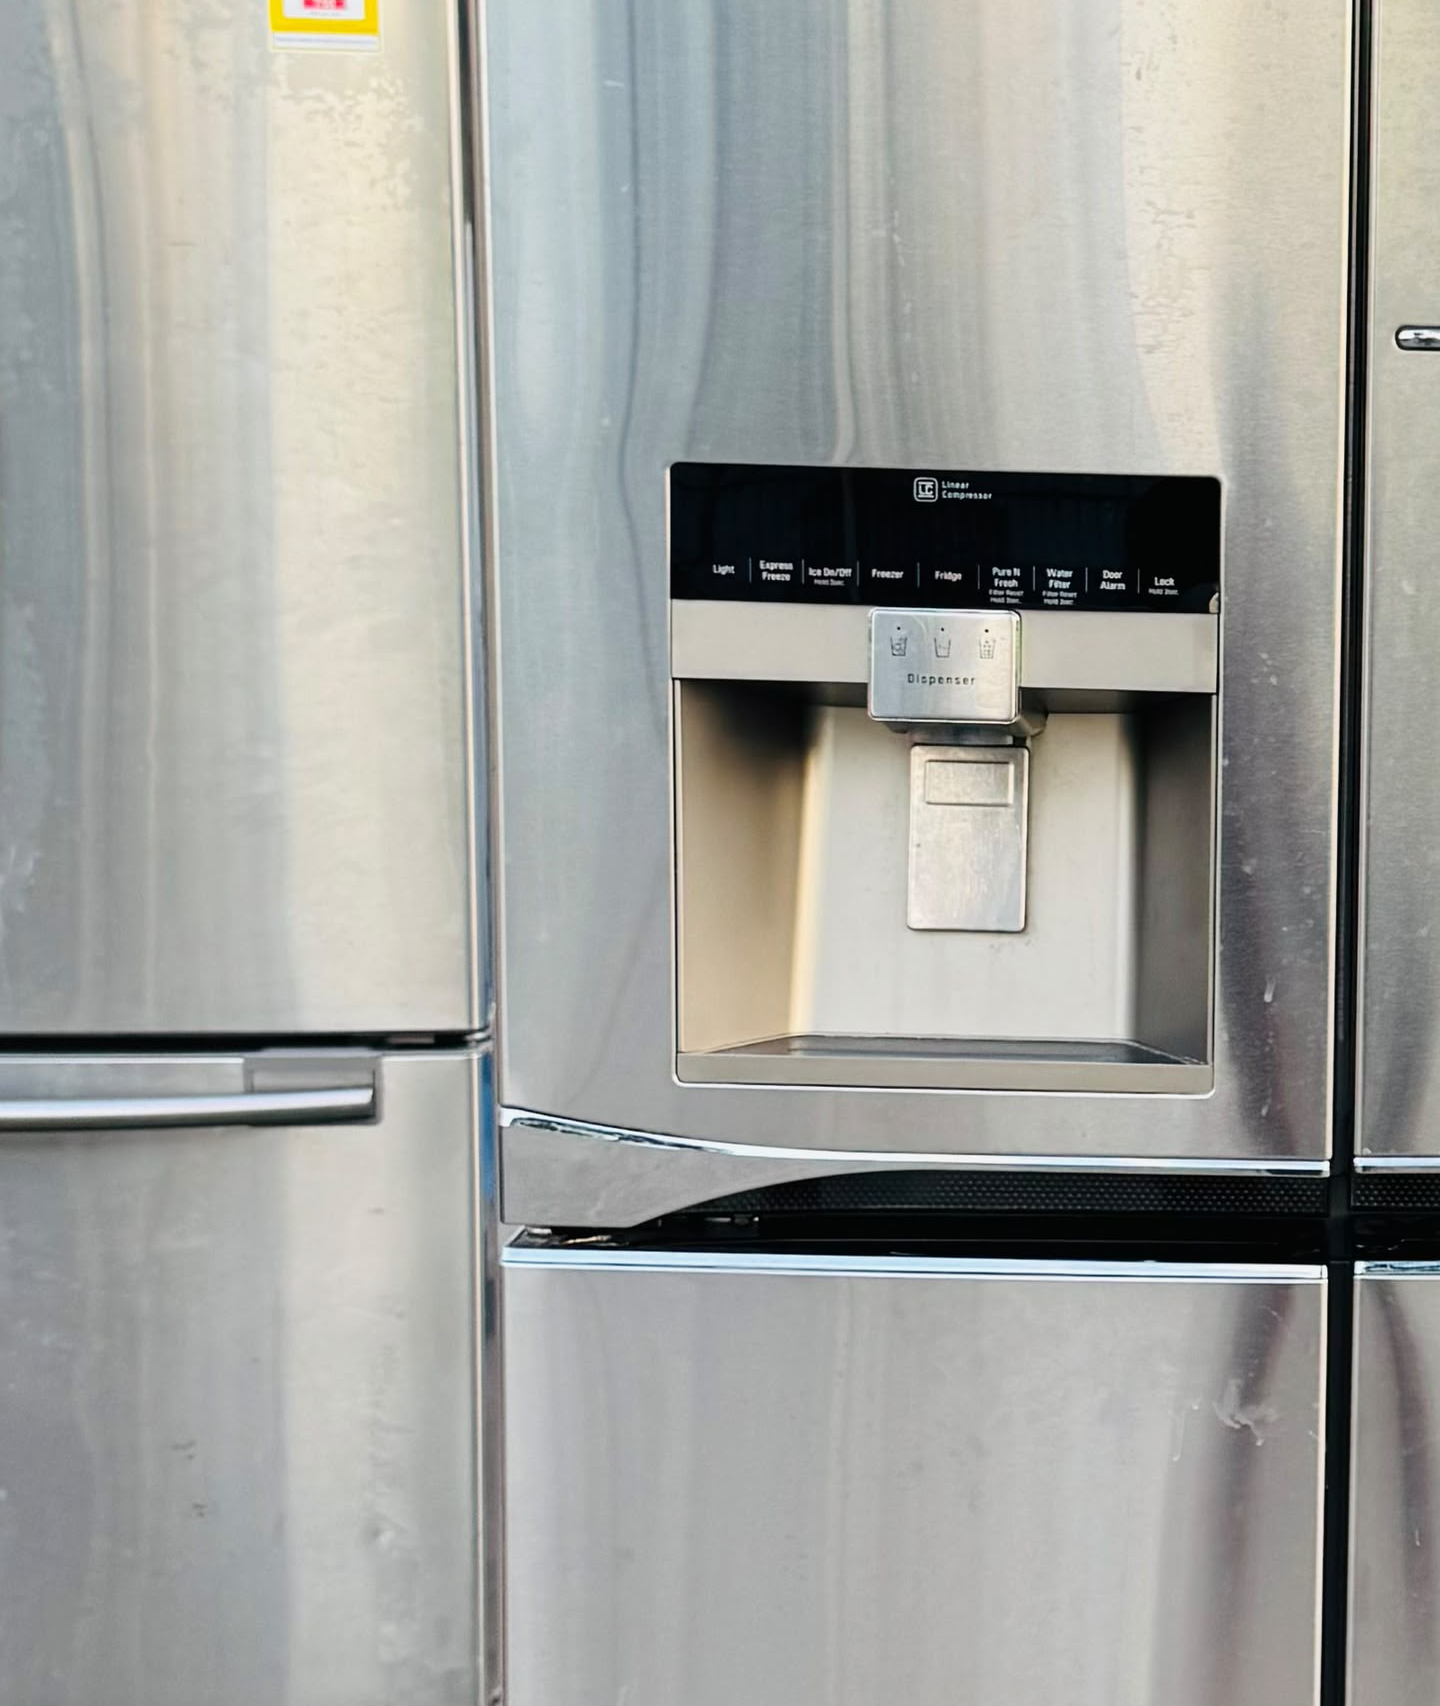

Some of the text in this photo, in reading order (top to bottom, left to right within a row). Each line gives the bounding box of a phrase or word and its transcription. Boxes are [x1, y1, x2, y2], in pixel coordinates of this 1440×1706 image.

[942, 480, 970, 489] Linear
[941, 490, 993, 500] Compressor
[713, 564, 735, 575] Light
[759, 560, 794, 571] Express
[762, 571, 791, 581] Freeze
[808, 567, 852, 578] Ice On/Off
[871, 568, 905, 579] Freezer
[934, 570, 963, 582] Fridge
[992, 566, 1012, 577] Pure
[1046, 568, 1073, 578] Water
[1102, 569, 1123, 579] Door
[994, 578, 1018, 588] Fresh
[1048, 579, 1071, 589] Filter
[1099, 580, 1126, 590] Alarm
[1154, 576, 1175, 586] Lock
[907, 673, 976, 686] Dispenser
